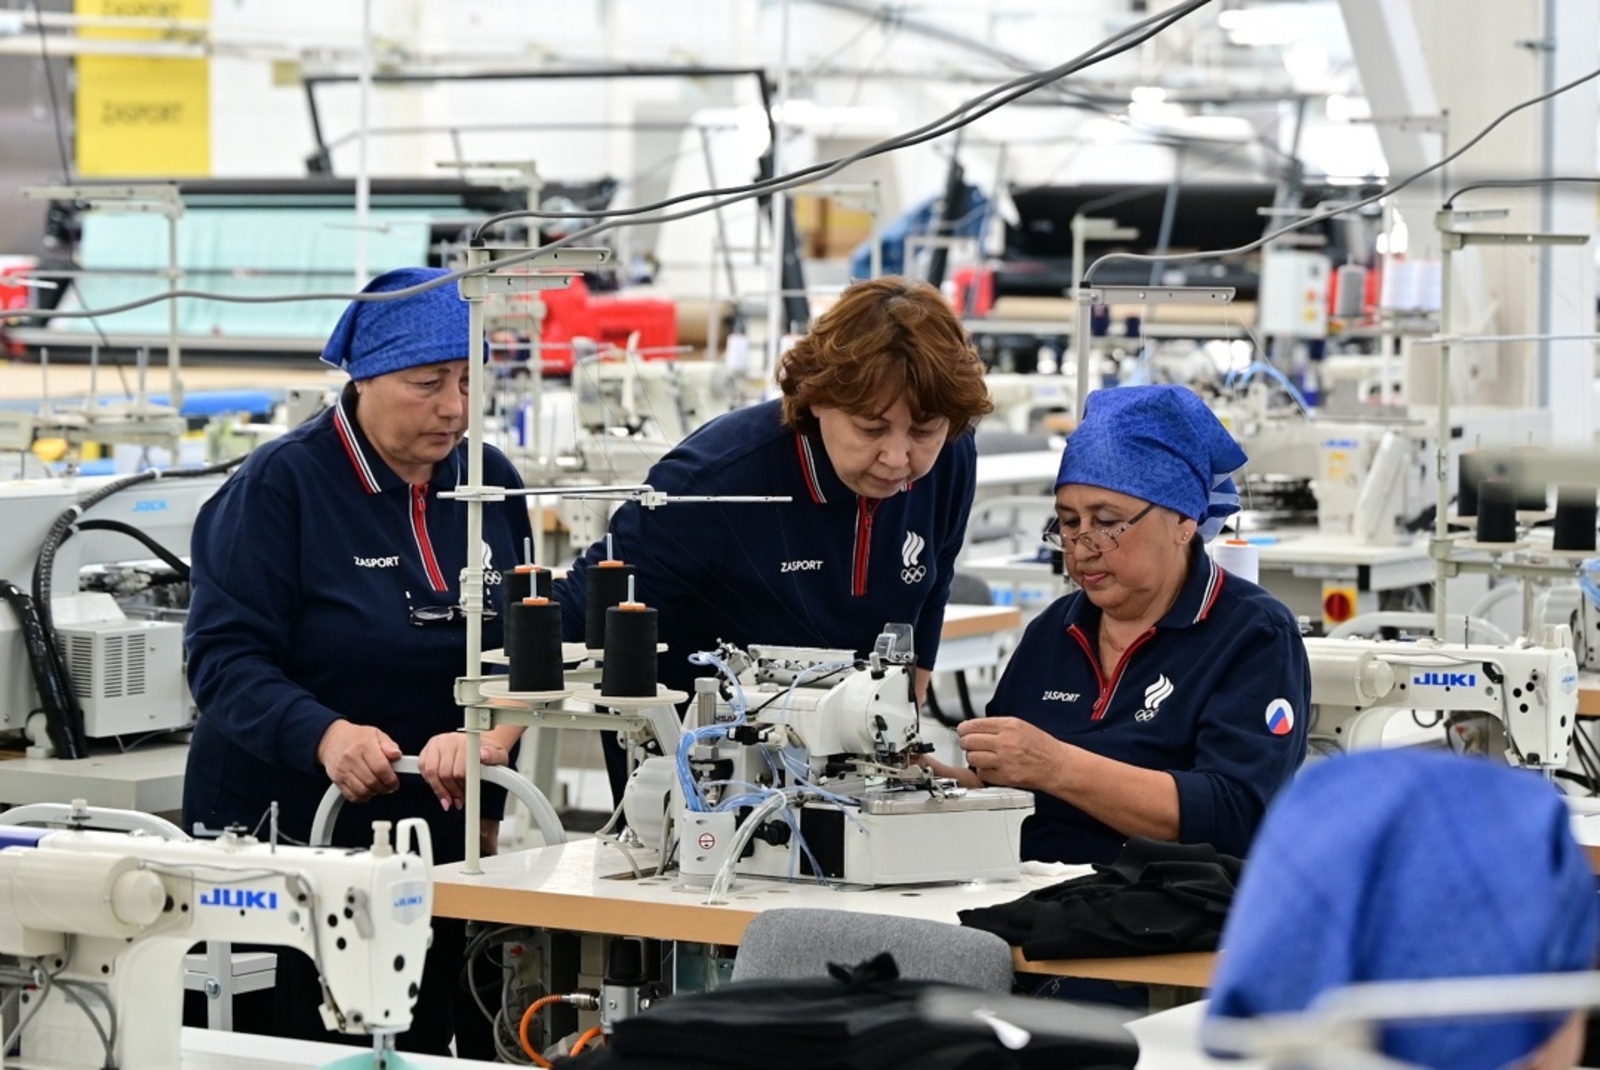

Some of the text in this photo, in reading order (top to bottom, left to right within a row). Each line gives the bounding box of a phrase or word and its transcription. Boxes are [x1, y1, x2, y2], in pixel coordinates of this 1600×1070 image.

[353, 556, 399, 568] ZASPORT
[780, 560, 824, 572] ZASPORT
[1413, 672, 1476, 687] JUKI
[1042, 690, 1080, 702] ZASPORT
[200, 888, 277, 909] JUKI
[394, 895, 422, 907] JUKI
